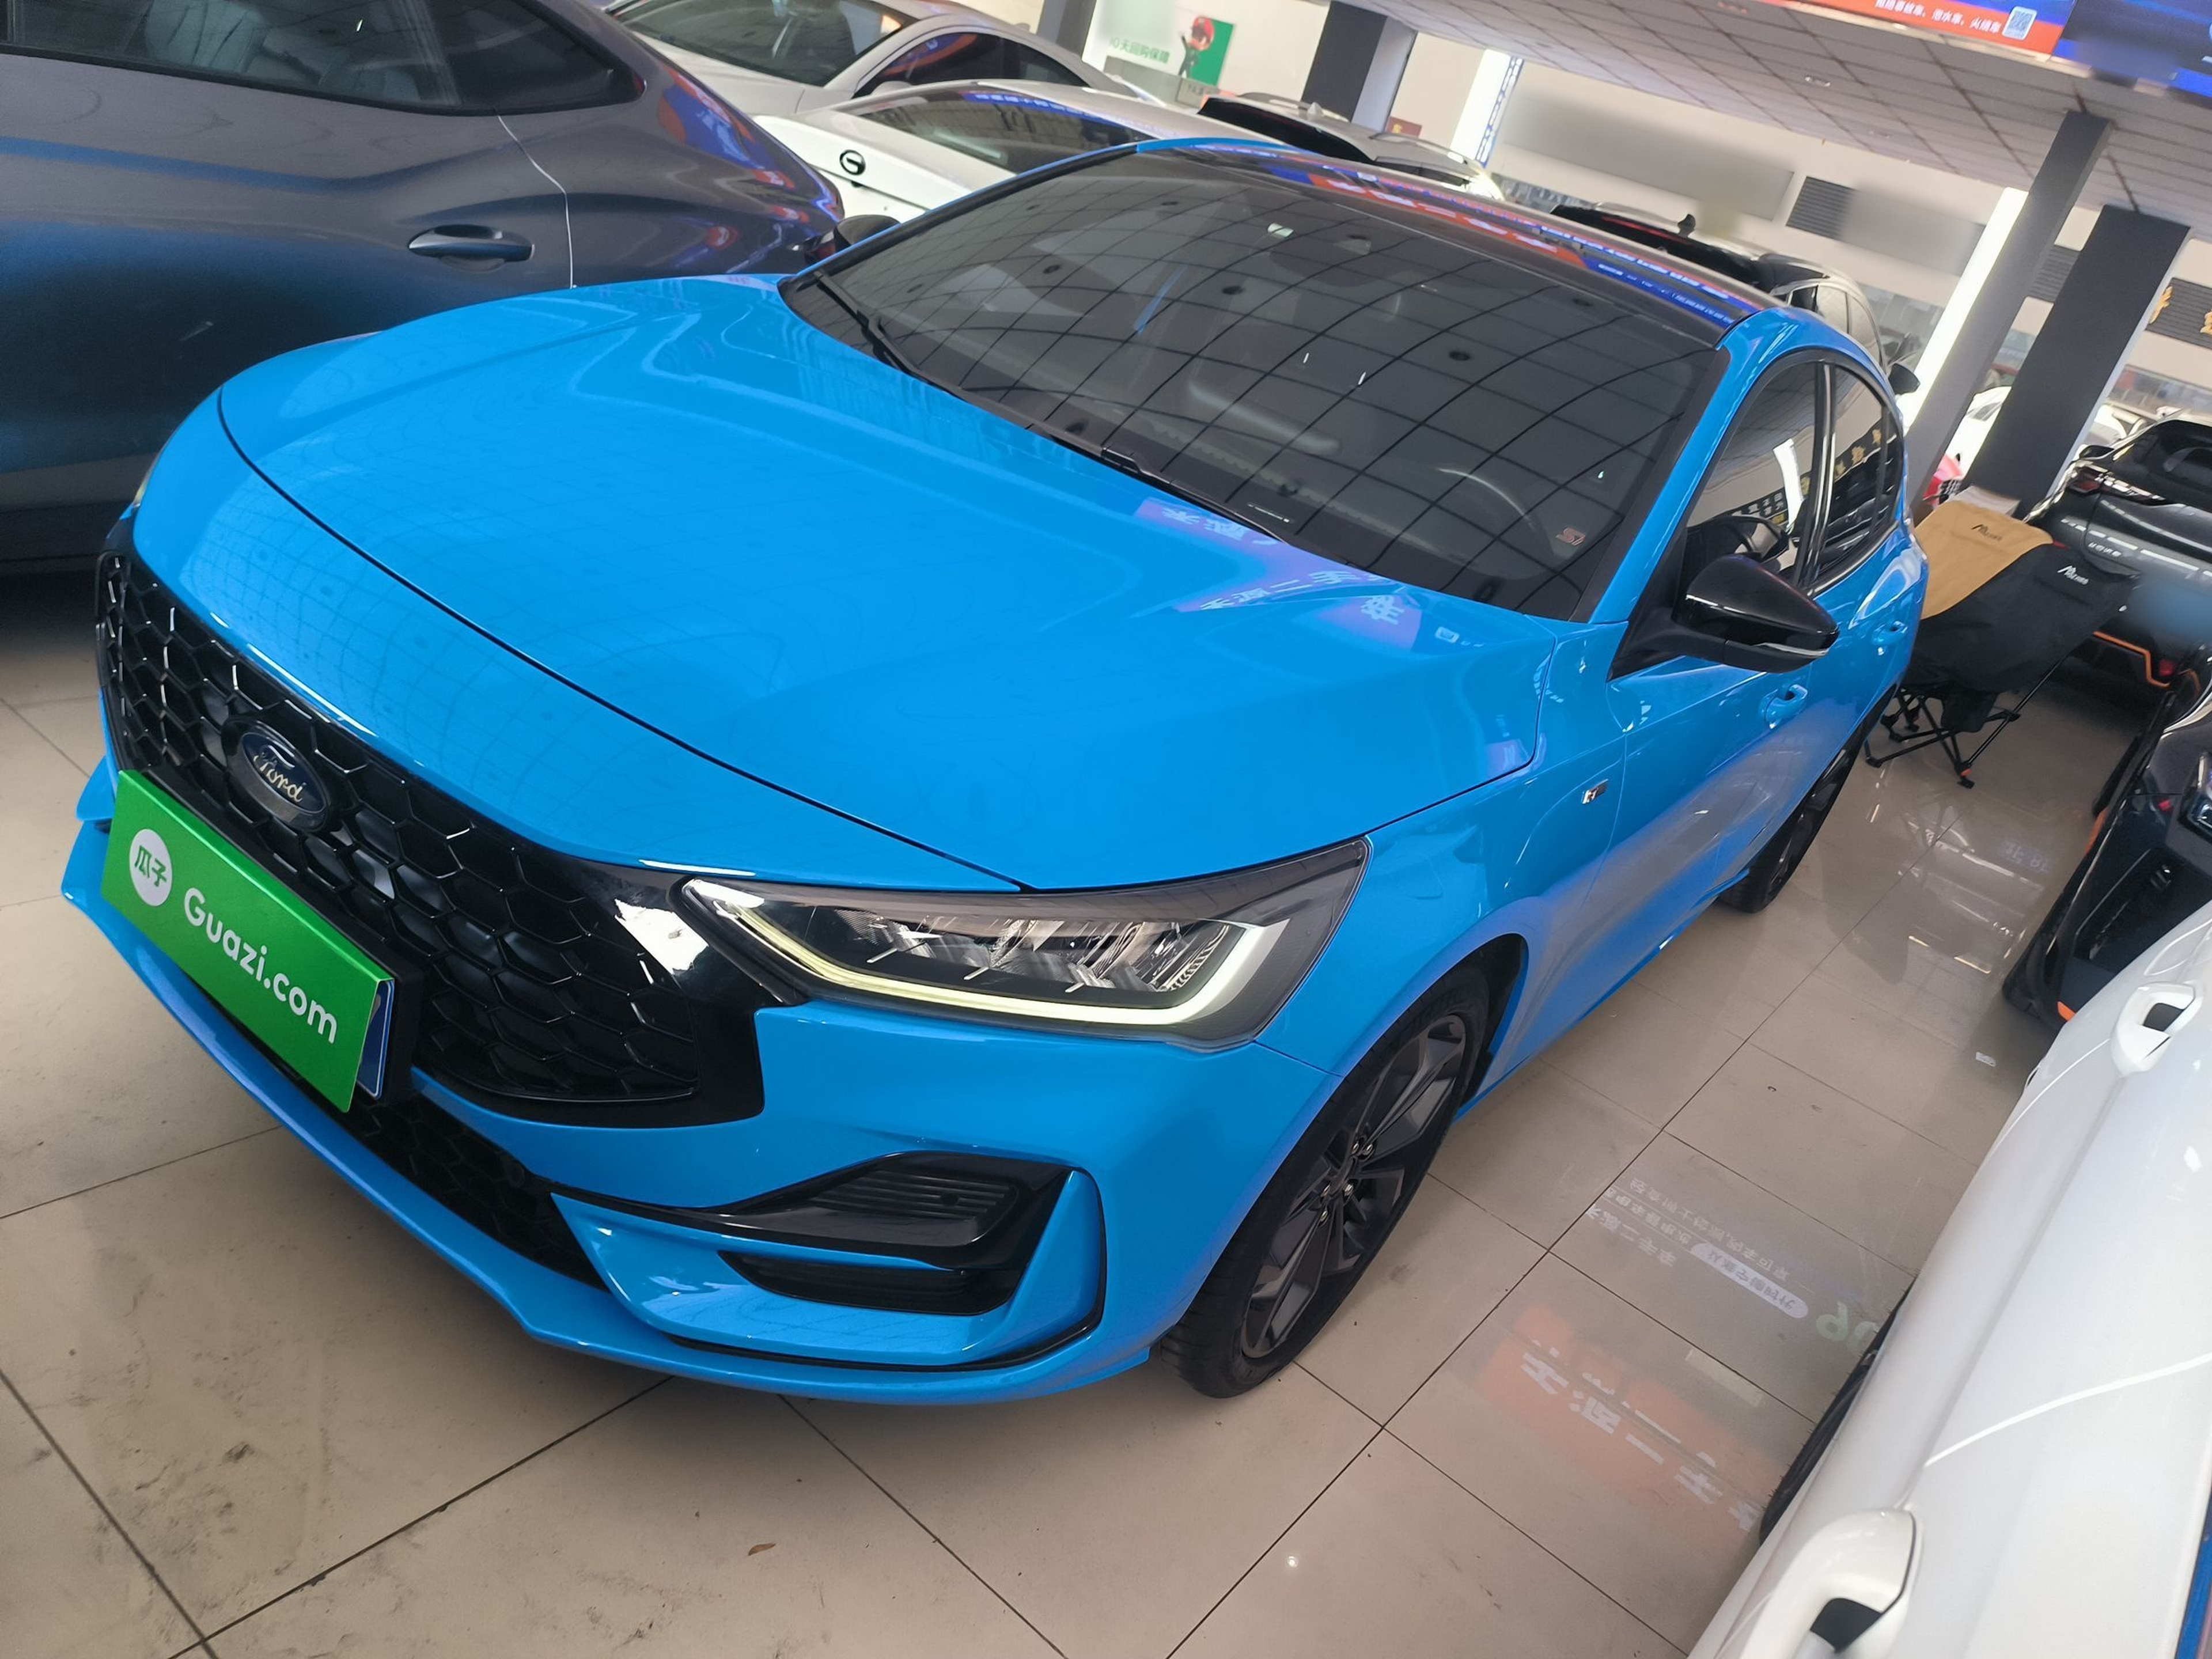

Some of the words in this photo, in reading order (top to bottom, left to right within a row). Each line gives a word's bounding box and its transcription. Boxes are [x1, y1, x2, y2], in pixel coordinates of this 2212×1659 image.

[253, 745, 306, 804] Ford
[134, 844, 168, 888] 瓜子
[184, 888, 337, 1043] Guazi.com
